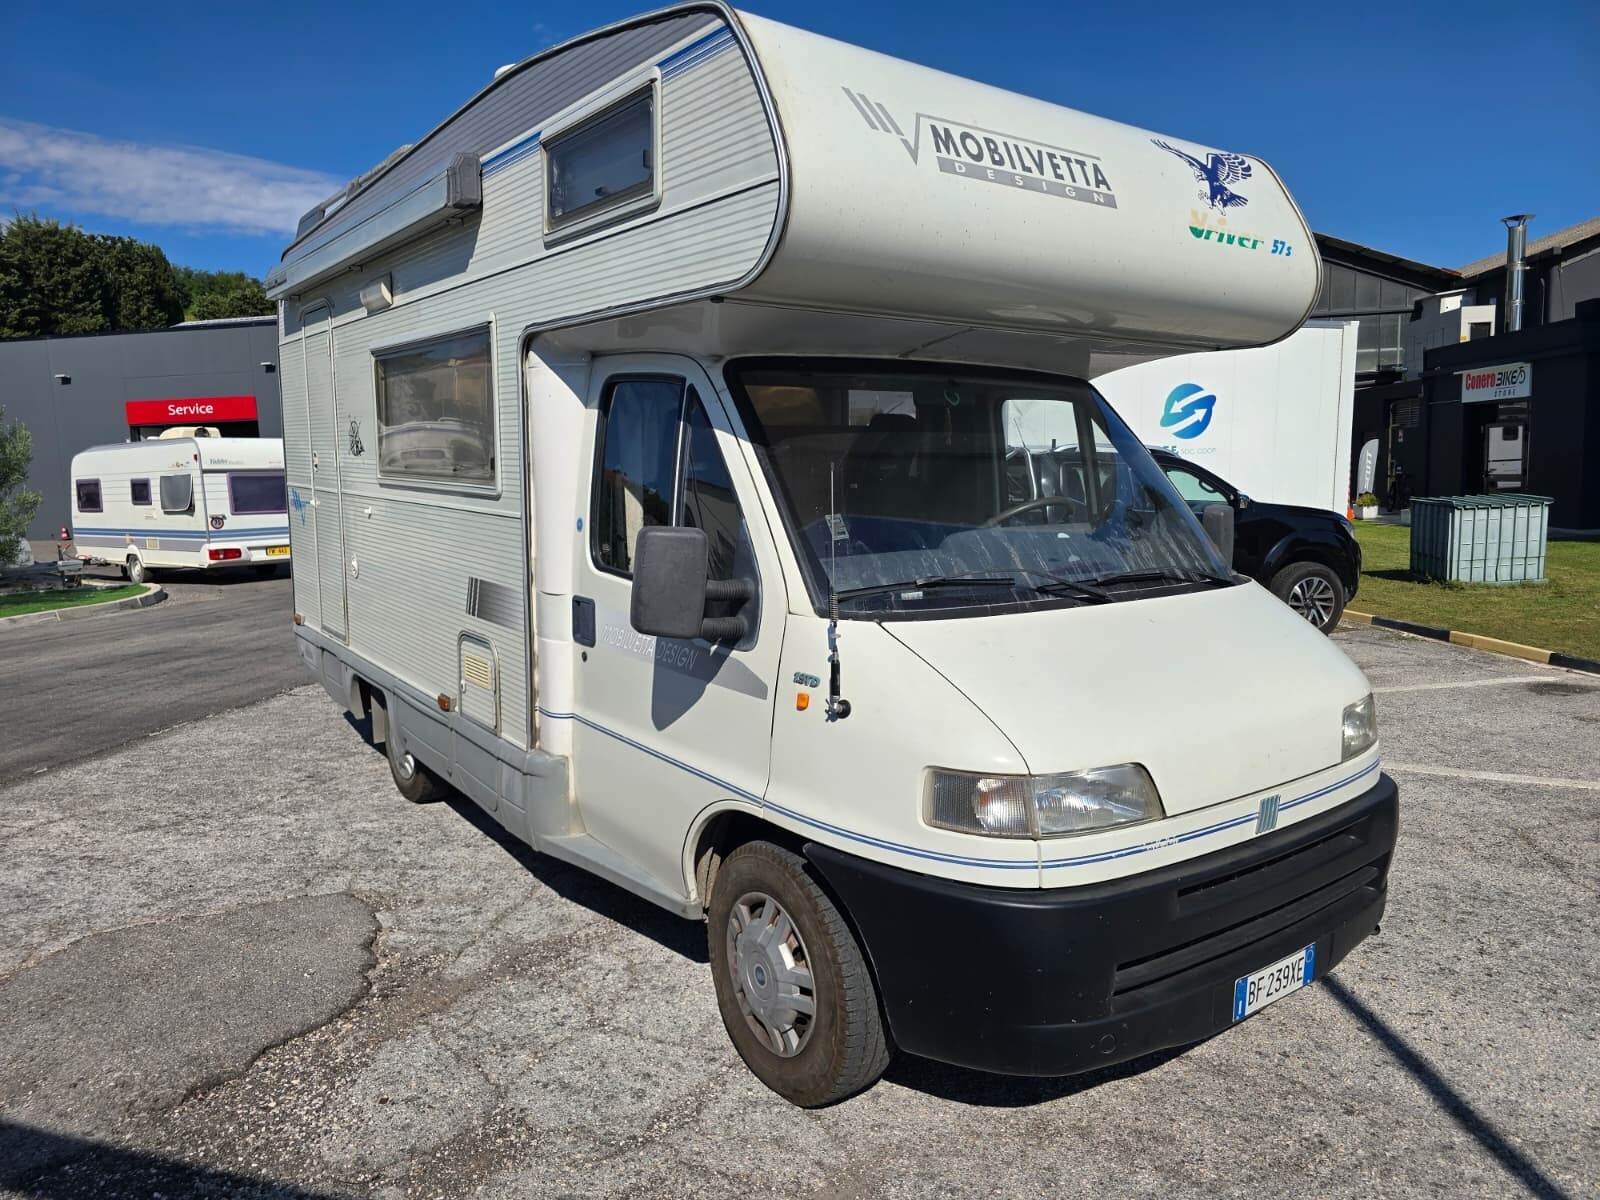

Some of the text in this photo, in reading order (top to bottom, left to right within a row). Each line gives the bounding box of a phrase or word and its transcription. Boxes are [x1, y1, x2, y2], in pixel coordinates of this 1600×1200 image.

[929, 124, 1113, 192] MOBILVETTA
[954, 162, 1105, 203] DESIGN
[168, 403, 214, 416] Service
[655, 640, 699, 671] DESIGN
